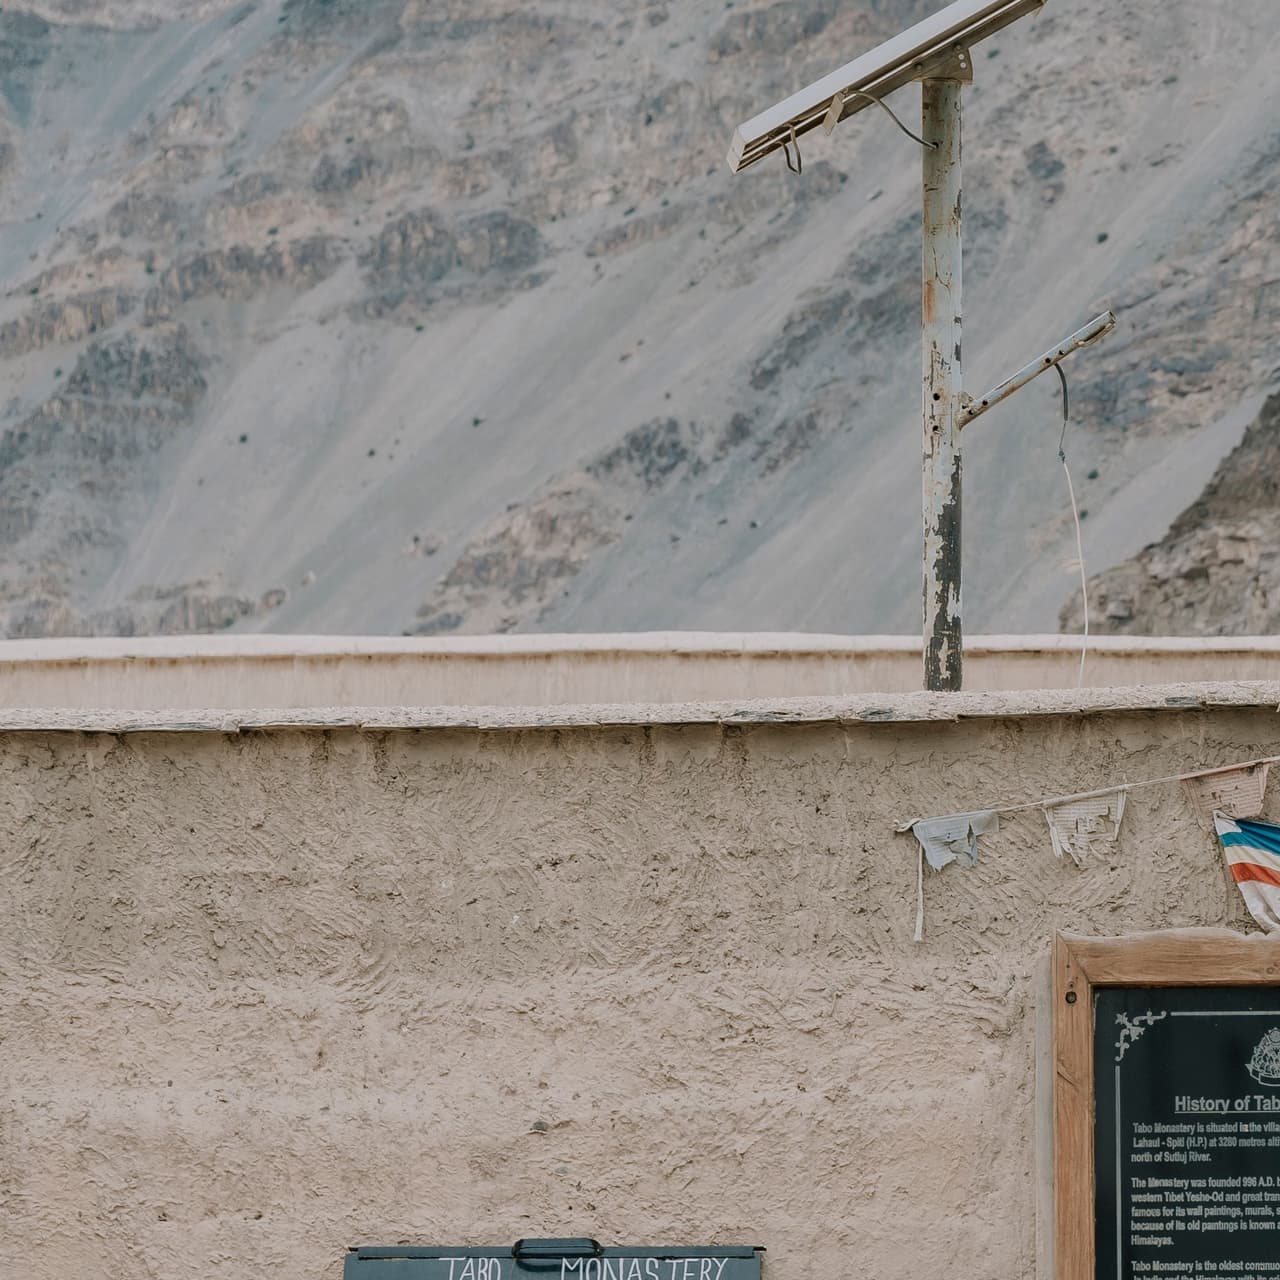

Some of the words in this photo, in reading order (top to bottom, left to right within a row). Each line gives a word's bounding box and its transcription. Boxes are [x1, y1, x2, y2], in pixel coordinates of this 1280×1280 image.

[1175, 1095, 1230, 1114] History
[1234, 1095, 1250, 1110] of
[1133, 1123, 1152, 1133] Tabo
[1153, 1123, 1195, 1135] Monastery
[1205, 1122, 1238, 1132] situated
[1248, 1122, 1262, 1132] the
[1132, 1137, 1160, 1147] Lahaul
[1238, 1137, 1266, 1146] metres
[1130, 1152, 1152, 1162] north
[1131, 1178, 1146, 1187] The
[1207, 1177, 1241, 1187] founded
[1257, 1177, 1275, 1186] A.D.
[1130, 1193, 1162, 1202] western
[1164, 1192, 1184, 1201] Tibet
[1241, 1192, 1262, 1203] great
[1131, 1207, 1161, 1216] famous
[1186, 1206, 1202, 1215] wall
[1203, 1205, 1243, 1218] paintings,
[1244, 1205, 1274, 1216] murals,
[1130, 1221, 1164, 1230] because
[1201, 1221, 1238, 1232] paintings
[1248, 1220, 1275, 1229] known
[1130, 1235, 1173, 1247] Himalayas.
[1131, 1261, 1151, 1271] Tabo
[1151, 1261, 1193, 1273] Monastery
[1218, 1261, 1243, 1270] oldest
